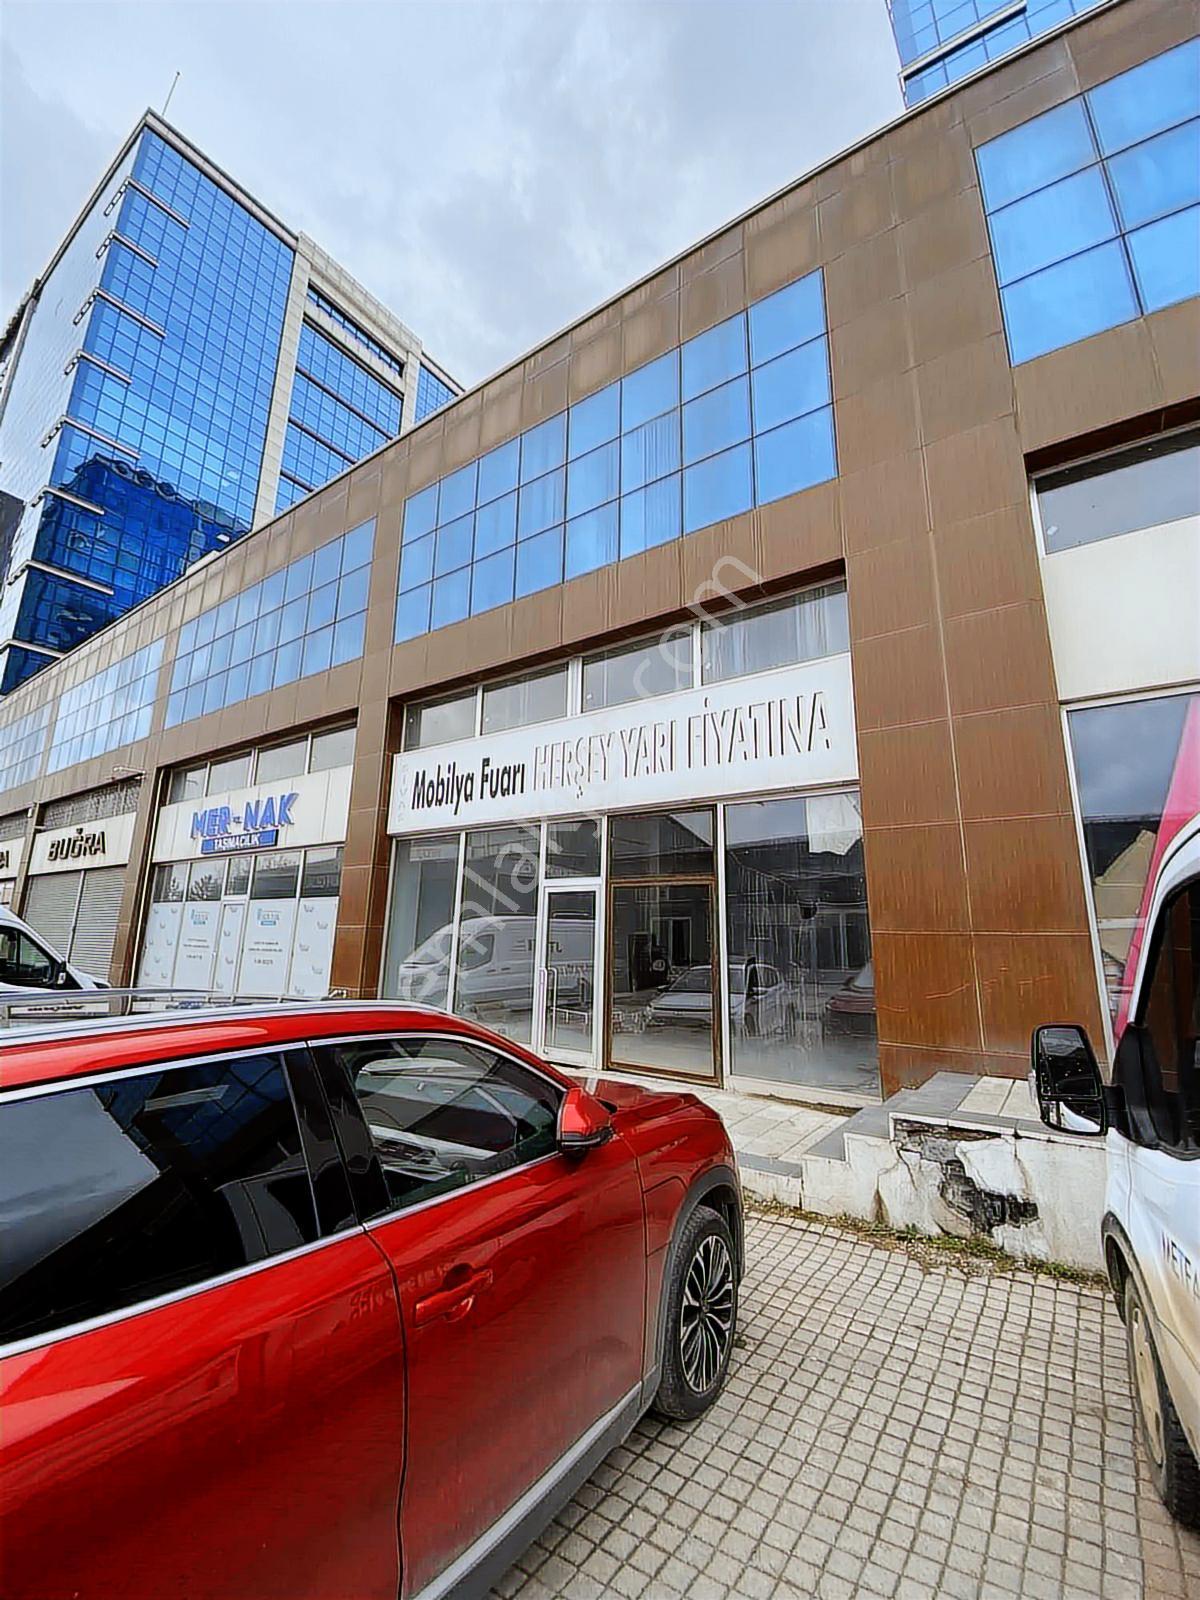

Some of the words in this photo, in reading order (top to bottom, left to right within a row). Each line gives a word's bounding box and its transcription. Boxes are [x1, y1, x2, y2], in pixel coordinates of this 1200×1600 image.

[411, 761, 474, 815] Mobilya
[480, 757, 525, 799] Fuarı
[533, 731, 615, 799] HERŞEY
[620, 720, 676, 777] YARI
[688, 697, 830, 769] FİYATINA
[48, 828, 106, 861] BUĞRA
